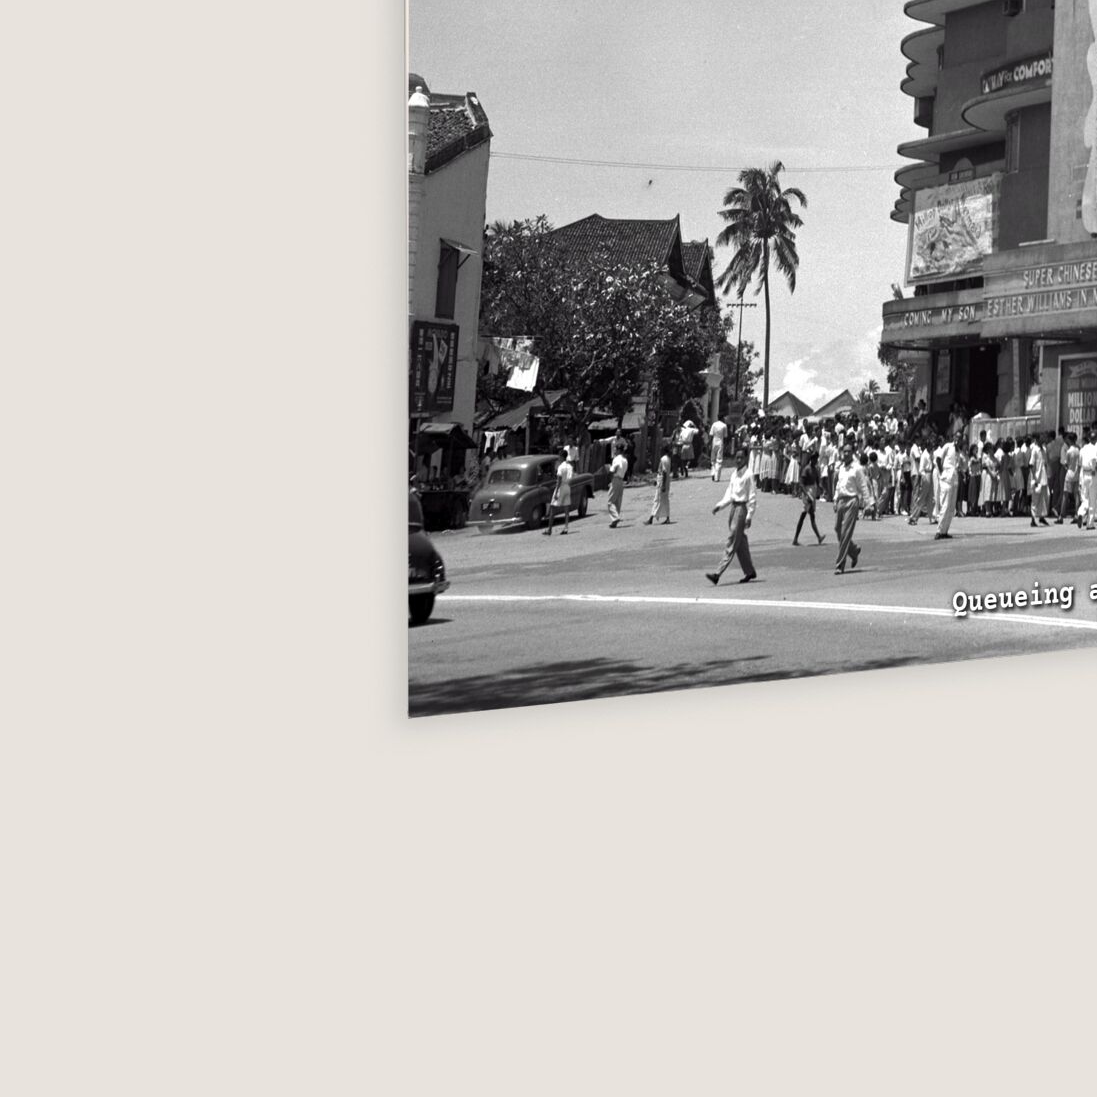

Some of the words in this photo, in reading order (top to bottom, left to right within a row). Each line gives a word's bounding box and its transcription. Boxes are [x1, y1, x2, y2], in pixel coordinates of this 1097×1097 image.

[1013, 58, 1053, 81] COMFOR
[1023, 267, 1053, 286] SUPER
[1058, 262, 1097, 283] CHINESE
[987, 296, 1023, 316] ESTHER
[1025, 290, 1072, 313] WILLIAMS
[1077, 288, 1087, 305] IN
[903, 310, 932, 325] COMING
[941, 308, 953, 323] MY
[959, 305, 976, 320] SON
[1069, 407, 1096, 424] DOLLAR
